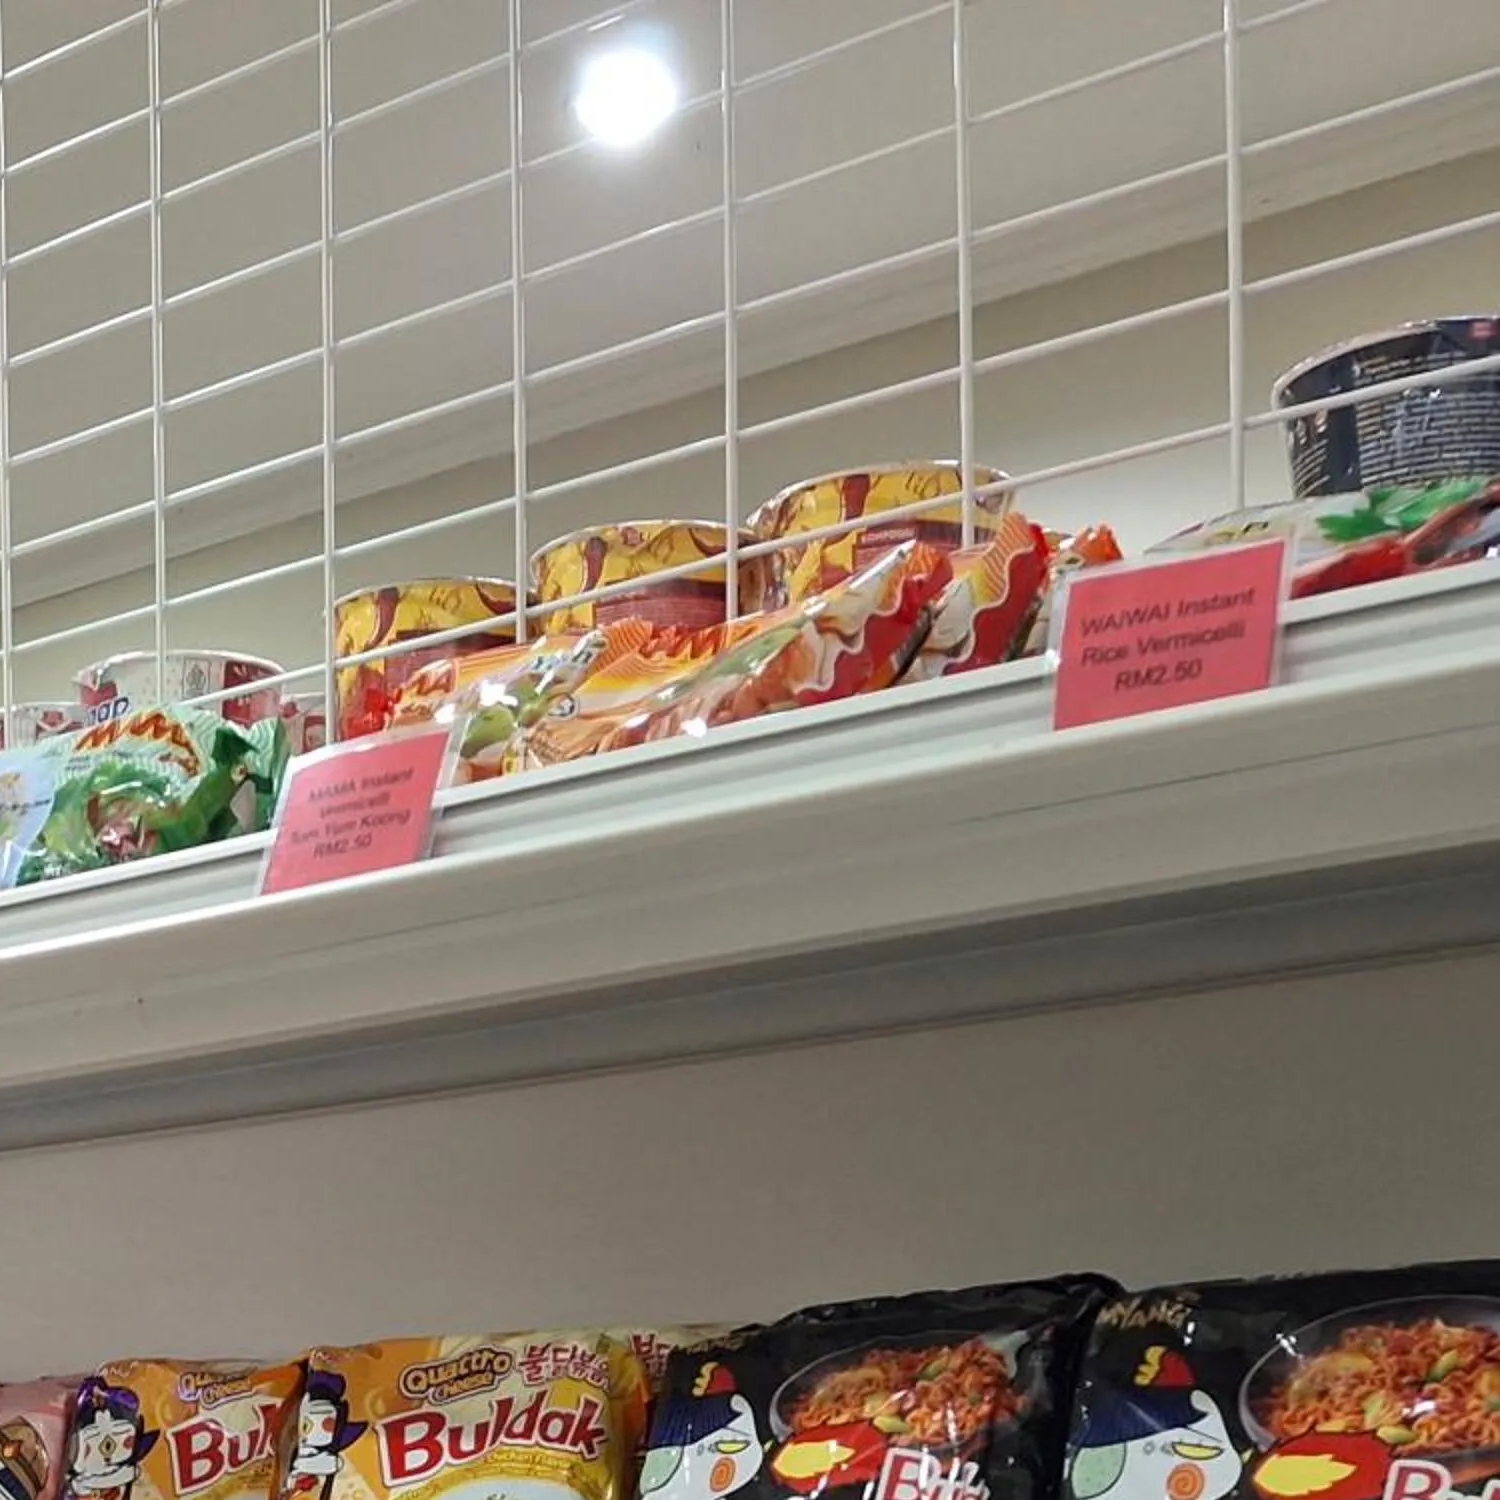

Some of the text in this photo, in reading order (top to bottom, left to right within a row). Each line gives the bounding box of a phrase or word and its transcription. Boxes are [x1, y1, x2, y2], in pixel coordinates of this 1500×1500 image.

[1177, 587, 1256, 621] Instant
[1080, 620, 1246, 667] Rice Vermicelli
[1113, 658, 1203, 693] RM2.50
[168, 1402, 282, 1494] Bul
[378, 1390, 610, 1486] Buldak
